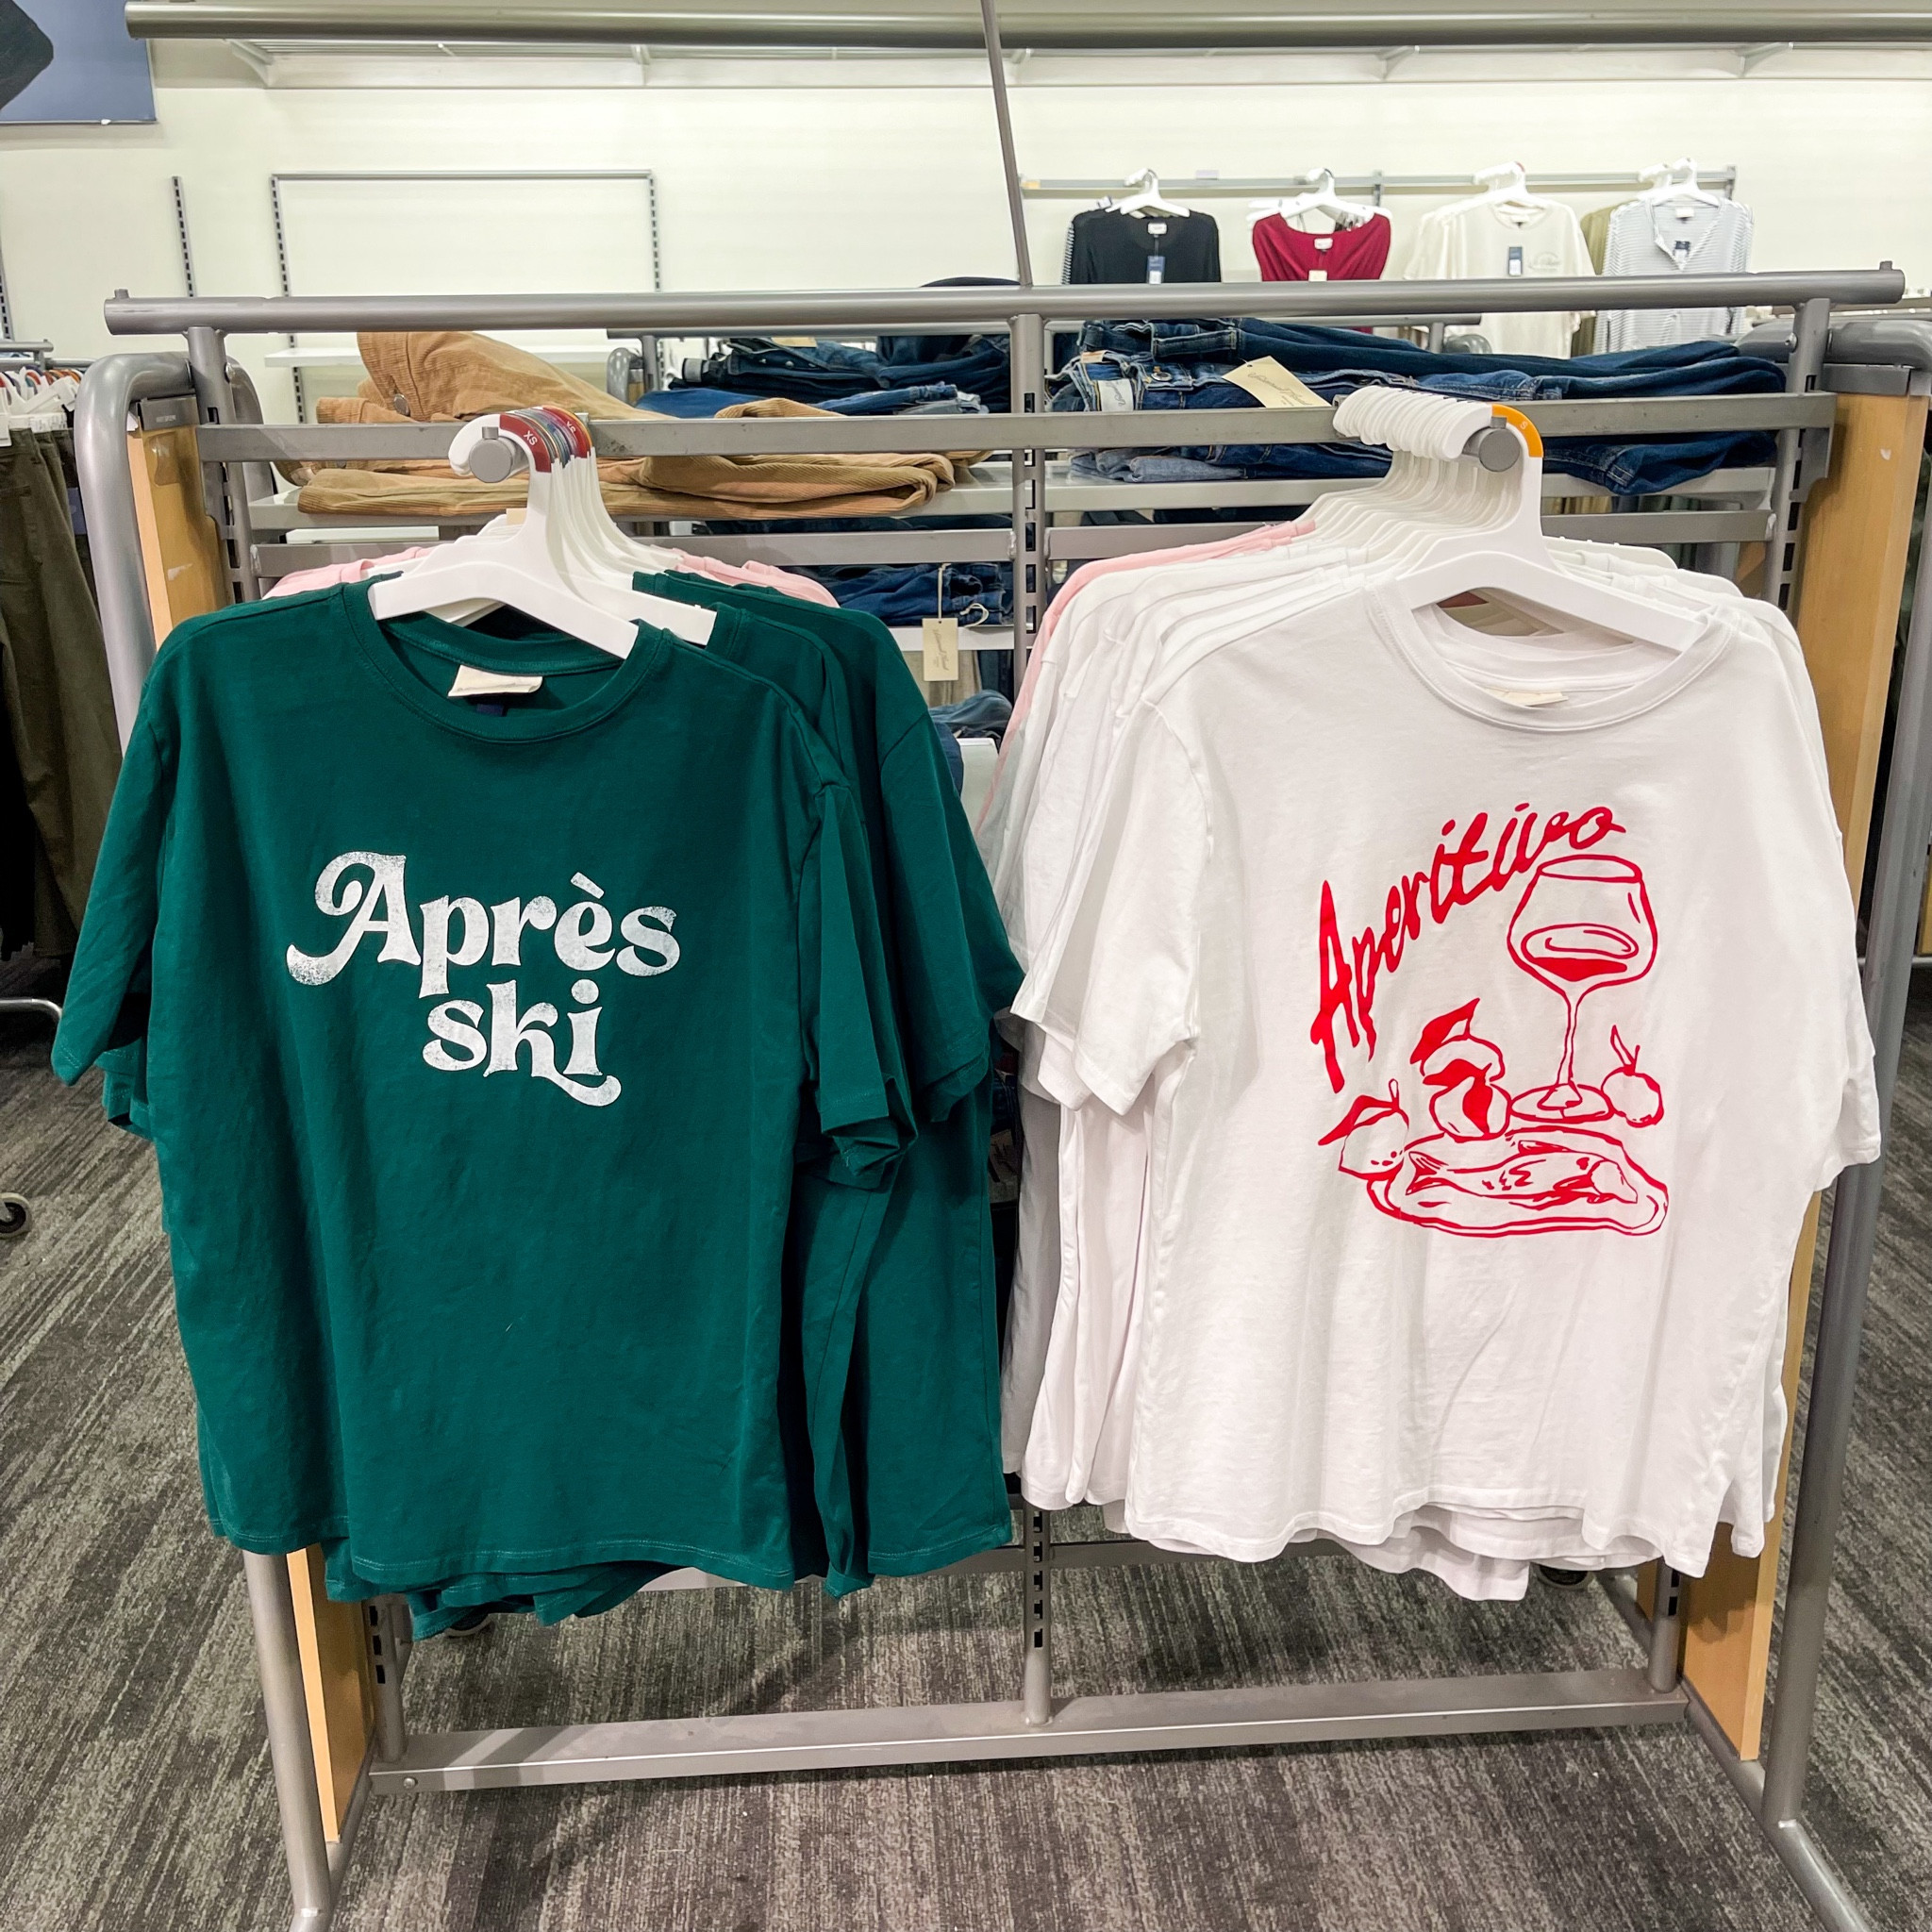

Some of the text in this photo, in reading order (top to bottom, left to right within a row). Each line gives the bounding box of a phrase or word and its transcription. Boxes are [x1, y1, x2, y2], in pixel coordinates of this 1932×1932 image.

[523, 430, 538, 446] XS
[1520, 420, 1528, 430] S
[286, 851, 680, 999] Après
[1310, 803, 1626, 1094] Aperitivo
[422, 978, 622, 1107] ski
